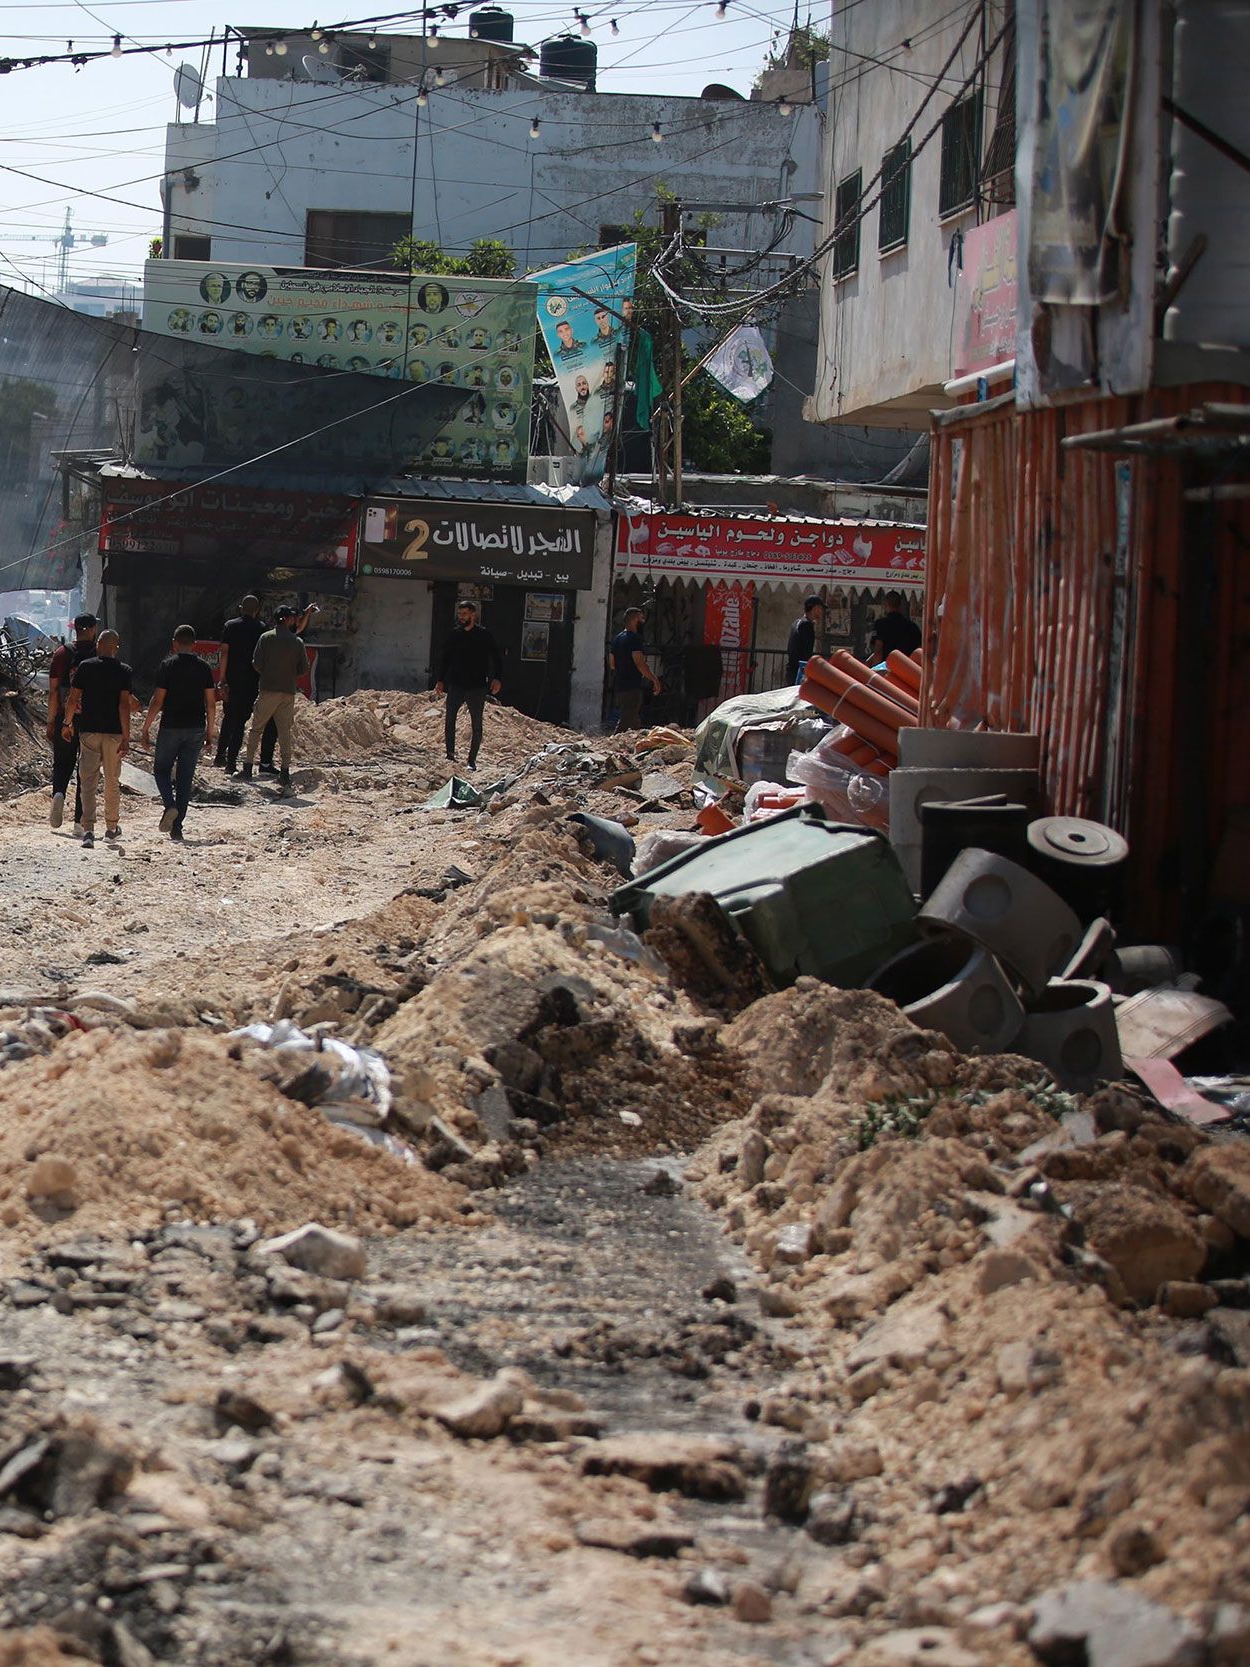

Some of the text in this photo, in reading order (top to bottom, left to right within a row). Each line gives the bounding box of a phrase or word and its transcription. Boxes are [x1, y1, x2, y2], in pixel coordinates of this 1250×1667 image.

[402, 518, 431, 560] 2
[528, 527, 581, 556] الفجر
[657, 521, 844, 549] دواجن ولحوم الياسين
[516, 570, 544, 581] تبديل
